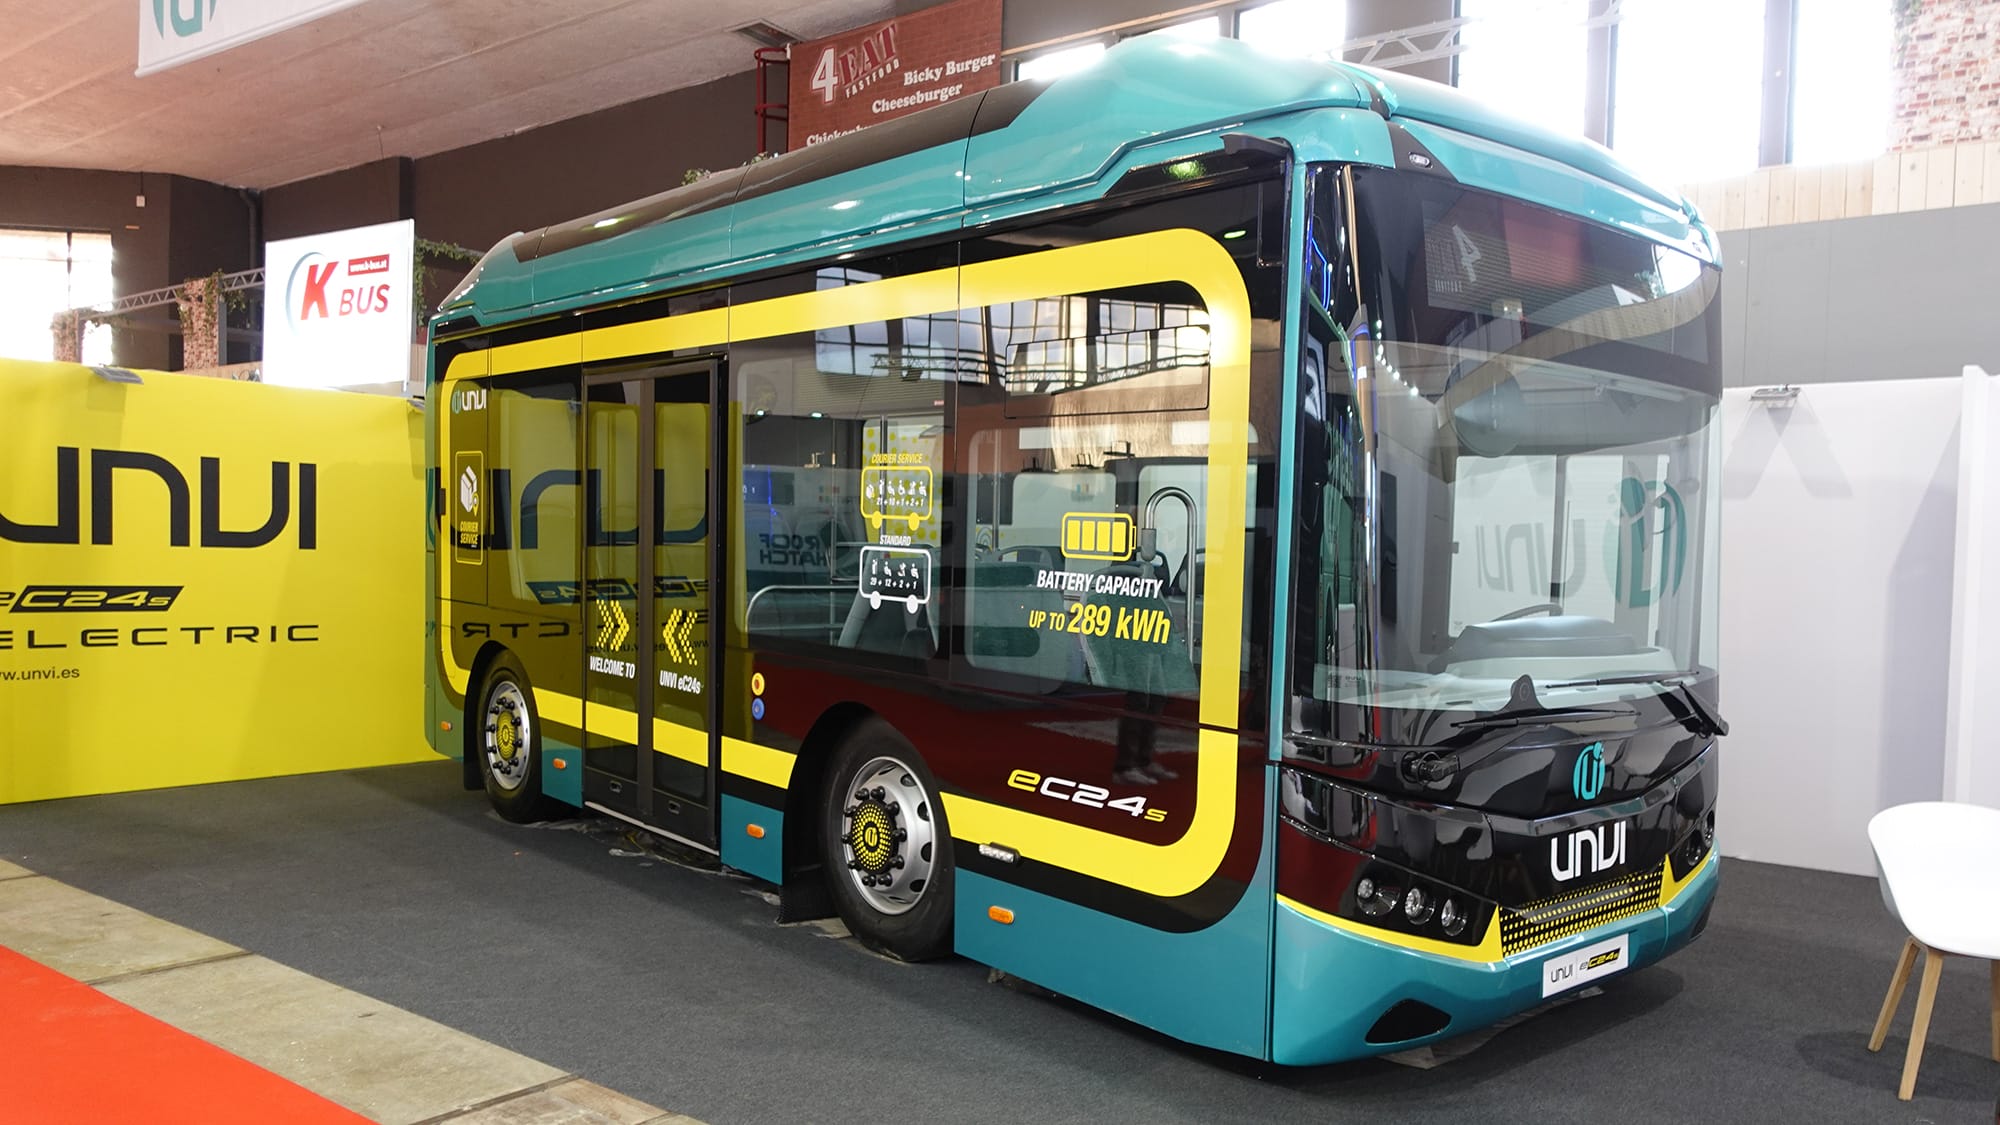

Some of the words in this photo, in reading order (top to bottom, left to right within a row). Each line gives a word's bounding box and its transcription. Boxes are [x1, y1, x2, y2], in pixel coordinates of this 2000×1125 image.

[811, 47, 839, 103] 4
[838, 21, 898, 87] EAT
[903, 66, 943, 87] Bicky
[946, 54, 996, 78] Burger
[845, 59, 900, 98] FASTFOOD
[872, 84, 963, 114] Cheeseburger
[301, 261, 339, 320] K
[339, 283, 391, 316] BUS
[872, 453, 896, 464] COURIER
[897, 453, 923, 464] SERVICE
[460, 521, 478, 532] COURIER
[460, 533, 478, 544] SERVICE
[880, 535, 911, 546] STANDARD
[1036, 569, 1095, 592] BATTERY
[1095, 574, 1163, 599] CAPACITY
[1028, 610, 1047, 628] UP
[1049, 612, 1066, 631] TO
[1067, 602, 1112, 637] 289
[1115, 607, 1171, 644] kWh
[589, 656, 624, 677] WELCOME
[625, 663, 635, 679] TO
[660, 670, 677, 688] UNVI
[677, 675, 701, 694] eC24s
[1007, 769, 1168, 822] eC24s
[1579, 951, 1619, 971] eC24s
